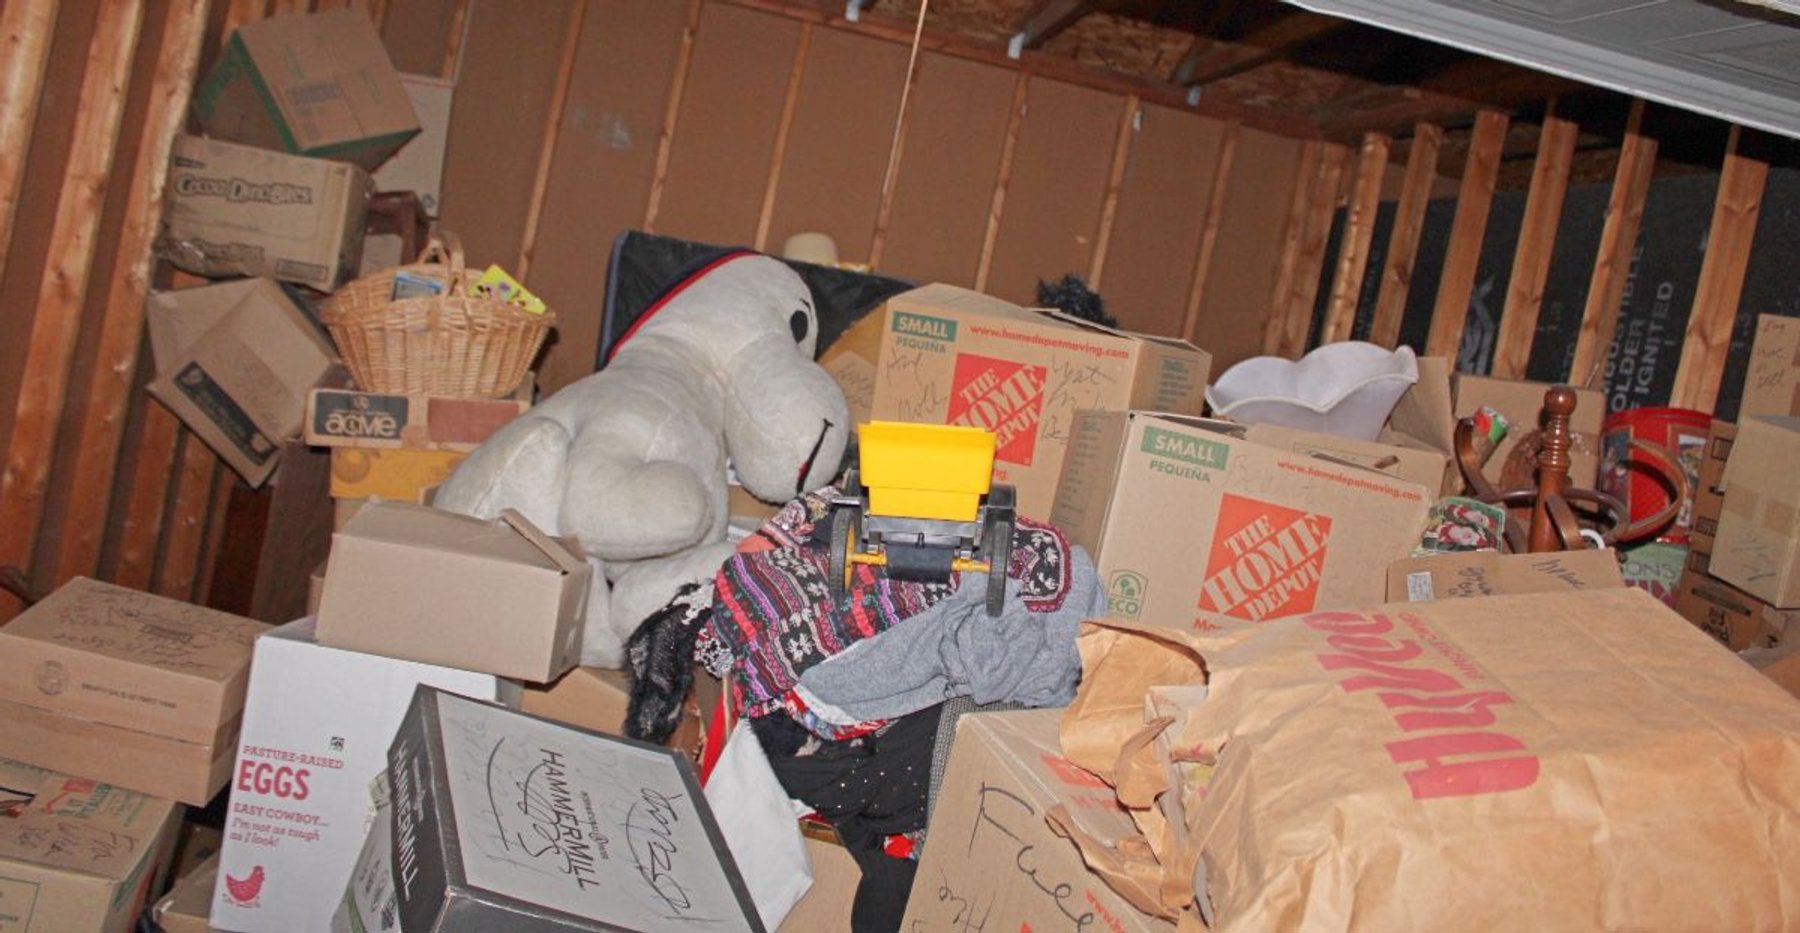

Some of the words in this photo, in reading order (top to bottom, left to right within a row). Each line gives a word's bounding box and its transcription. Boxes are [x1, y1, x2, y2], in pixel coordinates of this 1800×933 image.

[895, 335, 947, 354] PEQUEÑA
[898, 315, 949, 339] SMALL
[969, 324, 1130, 360] www.homedepotmoving.com
[1634, 281, 1674, 395] IGNITED
[960, 367, 999, 406] THE
[995, 402, 1041, 450] EPOT
[1153, 434, 1216, 463] SMALL
[1149, 459, 1212, 484] PEQUEÑA
[1224, 513, 1275, 557] THE
[1202, 512, 1329, 614] HOME
[1108, 598, 1140, 615] ECO
[1245, 558, 1322, 622] DEPOT
[242, 745, 345, 770] PASTURE-RAISED
[237, 759, 312, 801] EGGS
[233, 802, 264, 817] EASY
[393, 739, 420, 901] HAMMERMILL
[539, 747, 600, 891] HAMMERMILL
[229, 832, 243, 841] as
[252, 831, 280, 848] look!
[231, 817, 251, 830] I'm
[252, 823, 271, 834] not
[272, 826, 286, 836] as
[287, 828, 321, 843] tough
